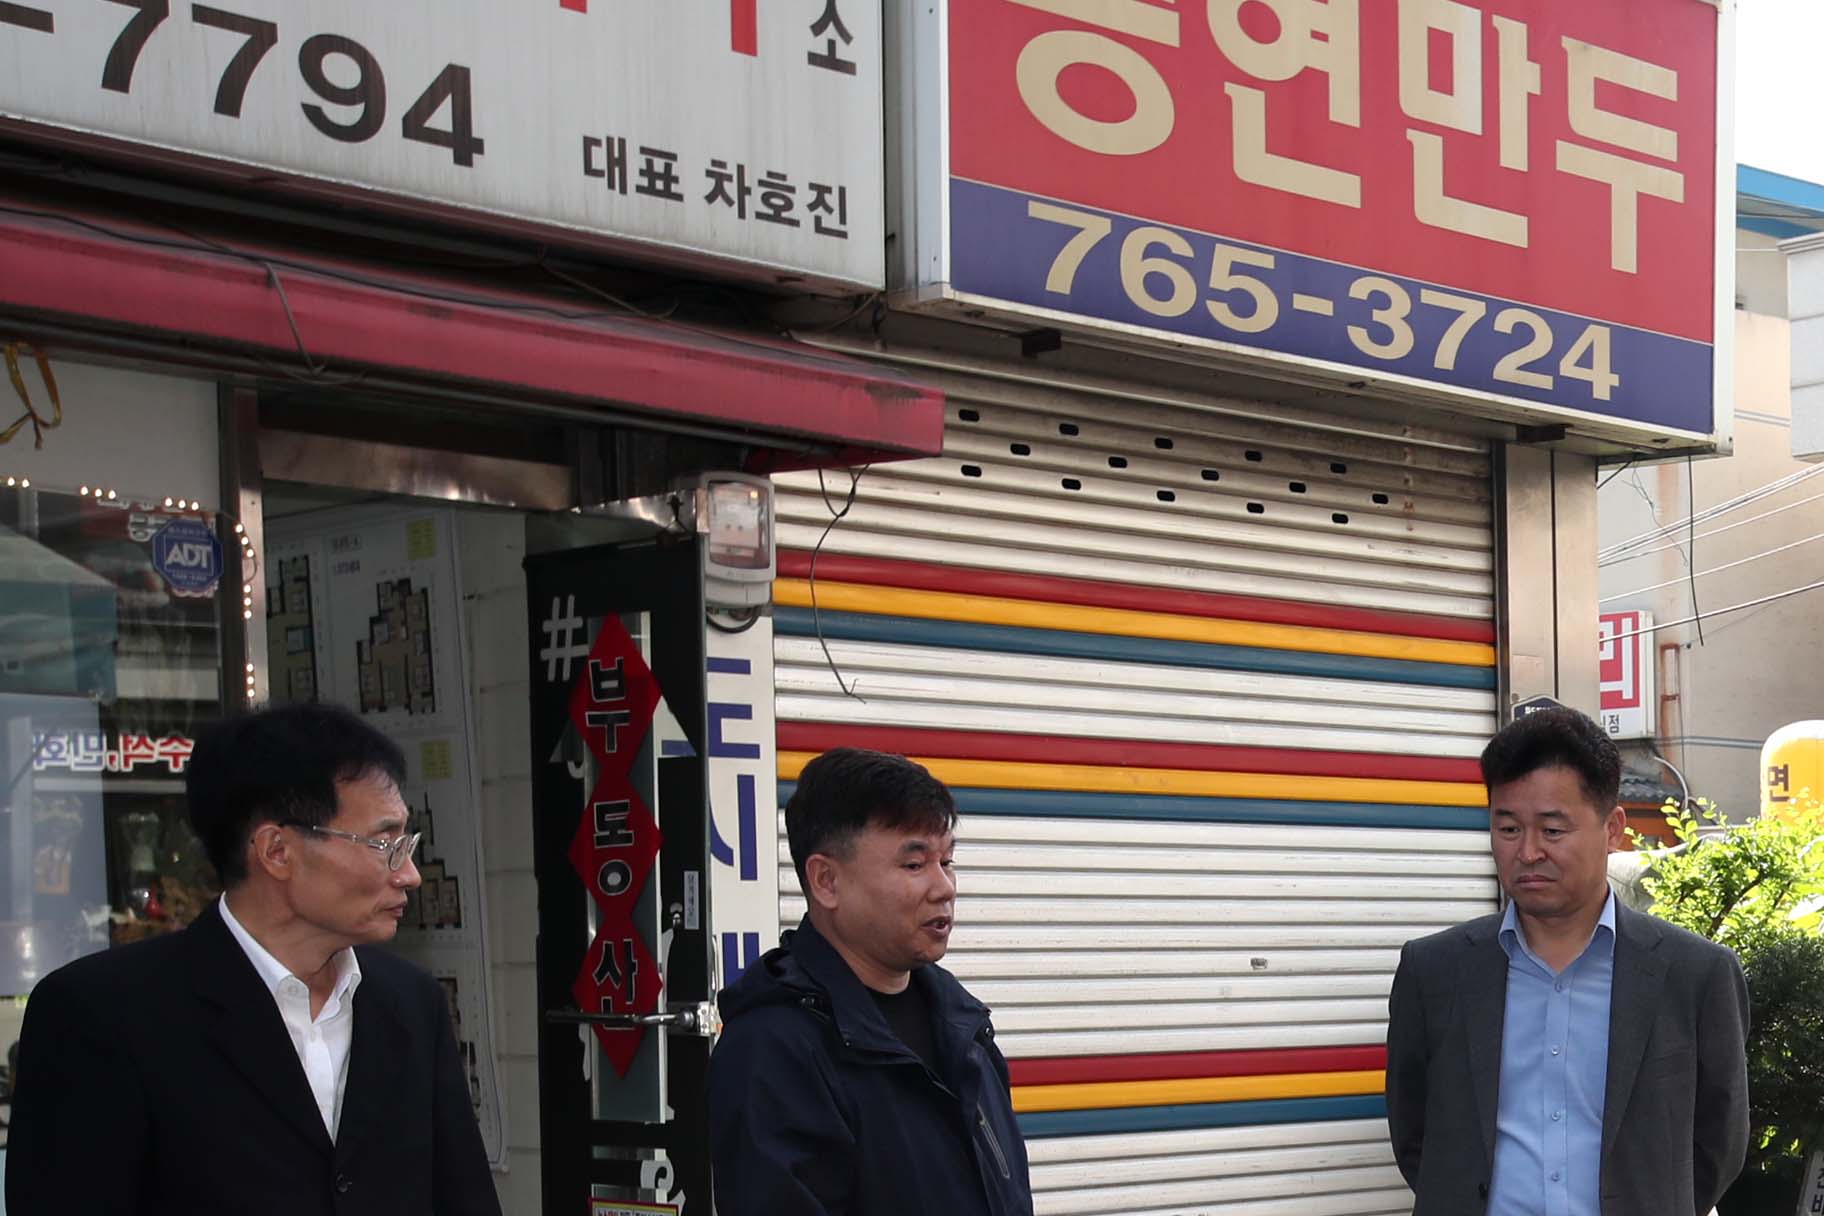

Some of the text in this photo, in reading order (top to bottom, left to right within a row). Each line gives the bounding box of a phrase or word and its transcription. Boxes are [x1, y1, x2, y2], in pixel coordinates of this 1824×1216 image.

[582, 136, 849, 239] 대표 차호진
[1027, 200, 1619, 401] 765-3724
[165, 543, 212, 568] ADT
